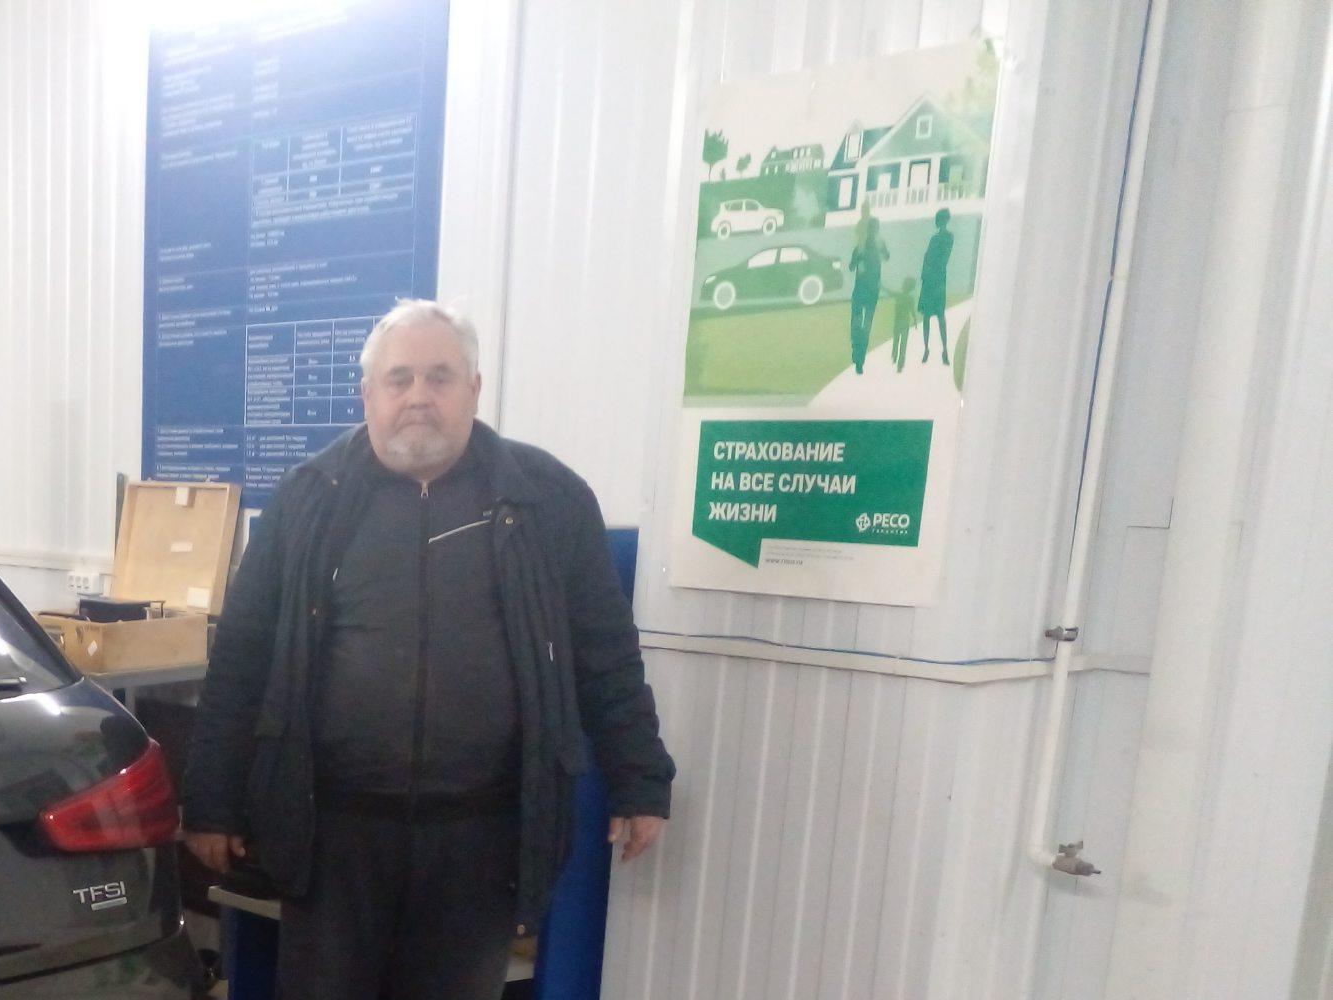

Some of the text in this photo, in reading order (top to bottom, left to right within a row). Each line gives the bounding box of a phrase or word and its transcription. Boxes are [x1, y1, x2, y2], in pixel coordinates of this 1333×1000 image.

[713, 441, 846, 463] СТРАХОВАНИЕ
[710, 471, 857, 495] НА ВСЕ СЛУЧАИ
[708, 501, 777, 523] ЖИЗНИ
[873, 512, 910, 528] РЕСО
[72, 881, 126, 904] TFSI
